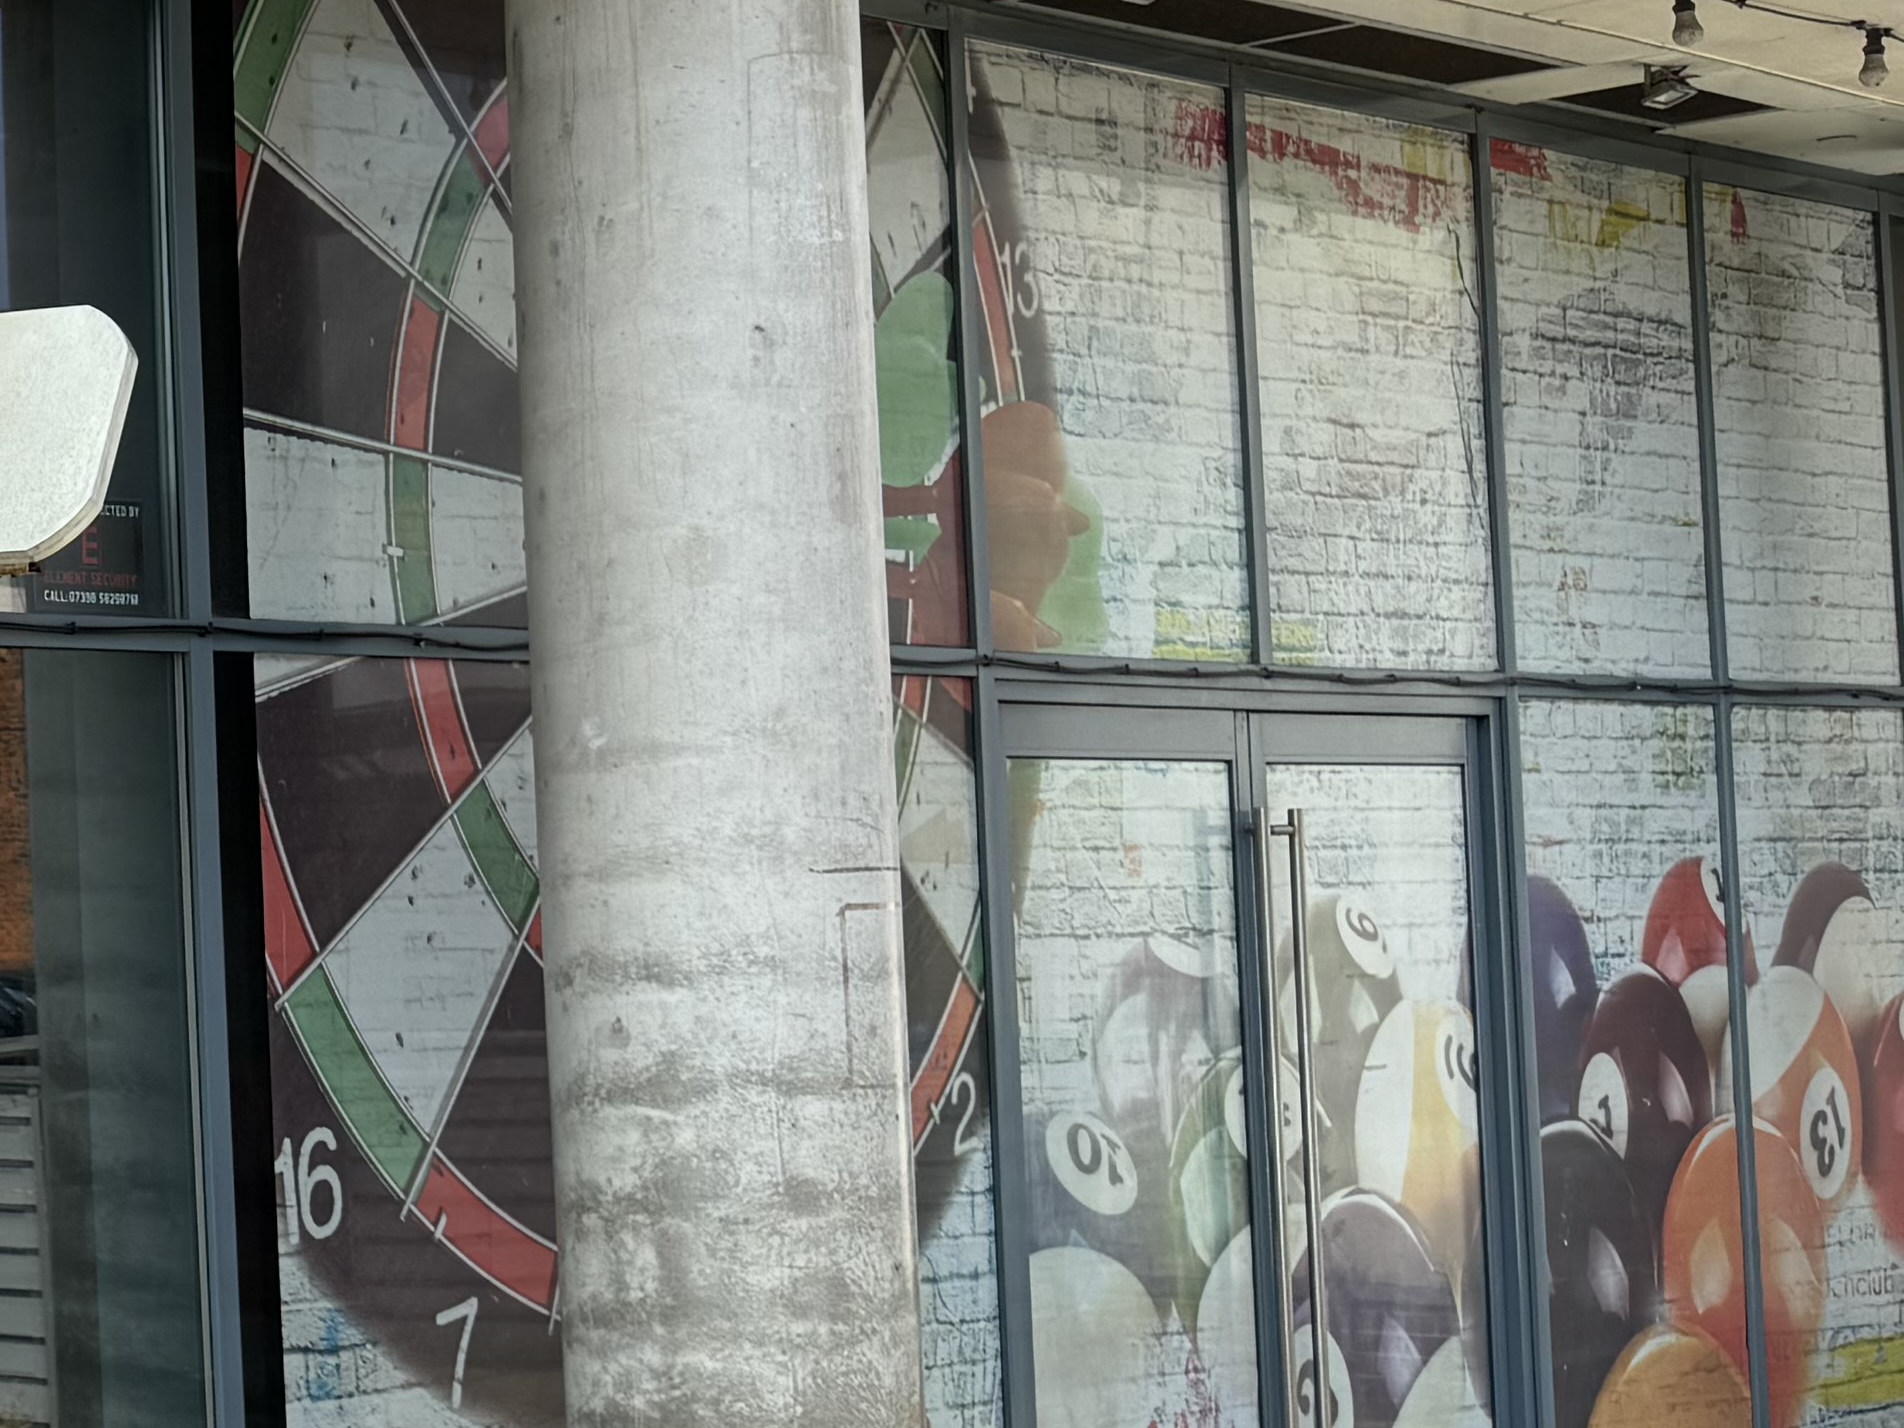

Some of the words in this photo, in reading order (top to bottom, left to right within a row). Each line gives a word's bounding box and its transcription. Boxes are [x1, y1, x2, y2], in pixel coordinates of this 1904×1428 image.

[998, 241, 1040, 318] 13
[950, 1070, 978, 1158] 2
[275, 1125, 344, 1246] 16
[435, 1297, 480, 1409] 7
